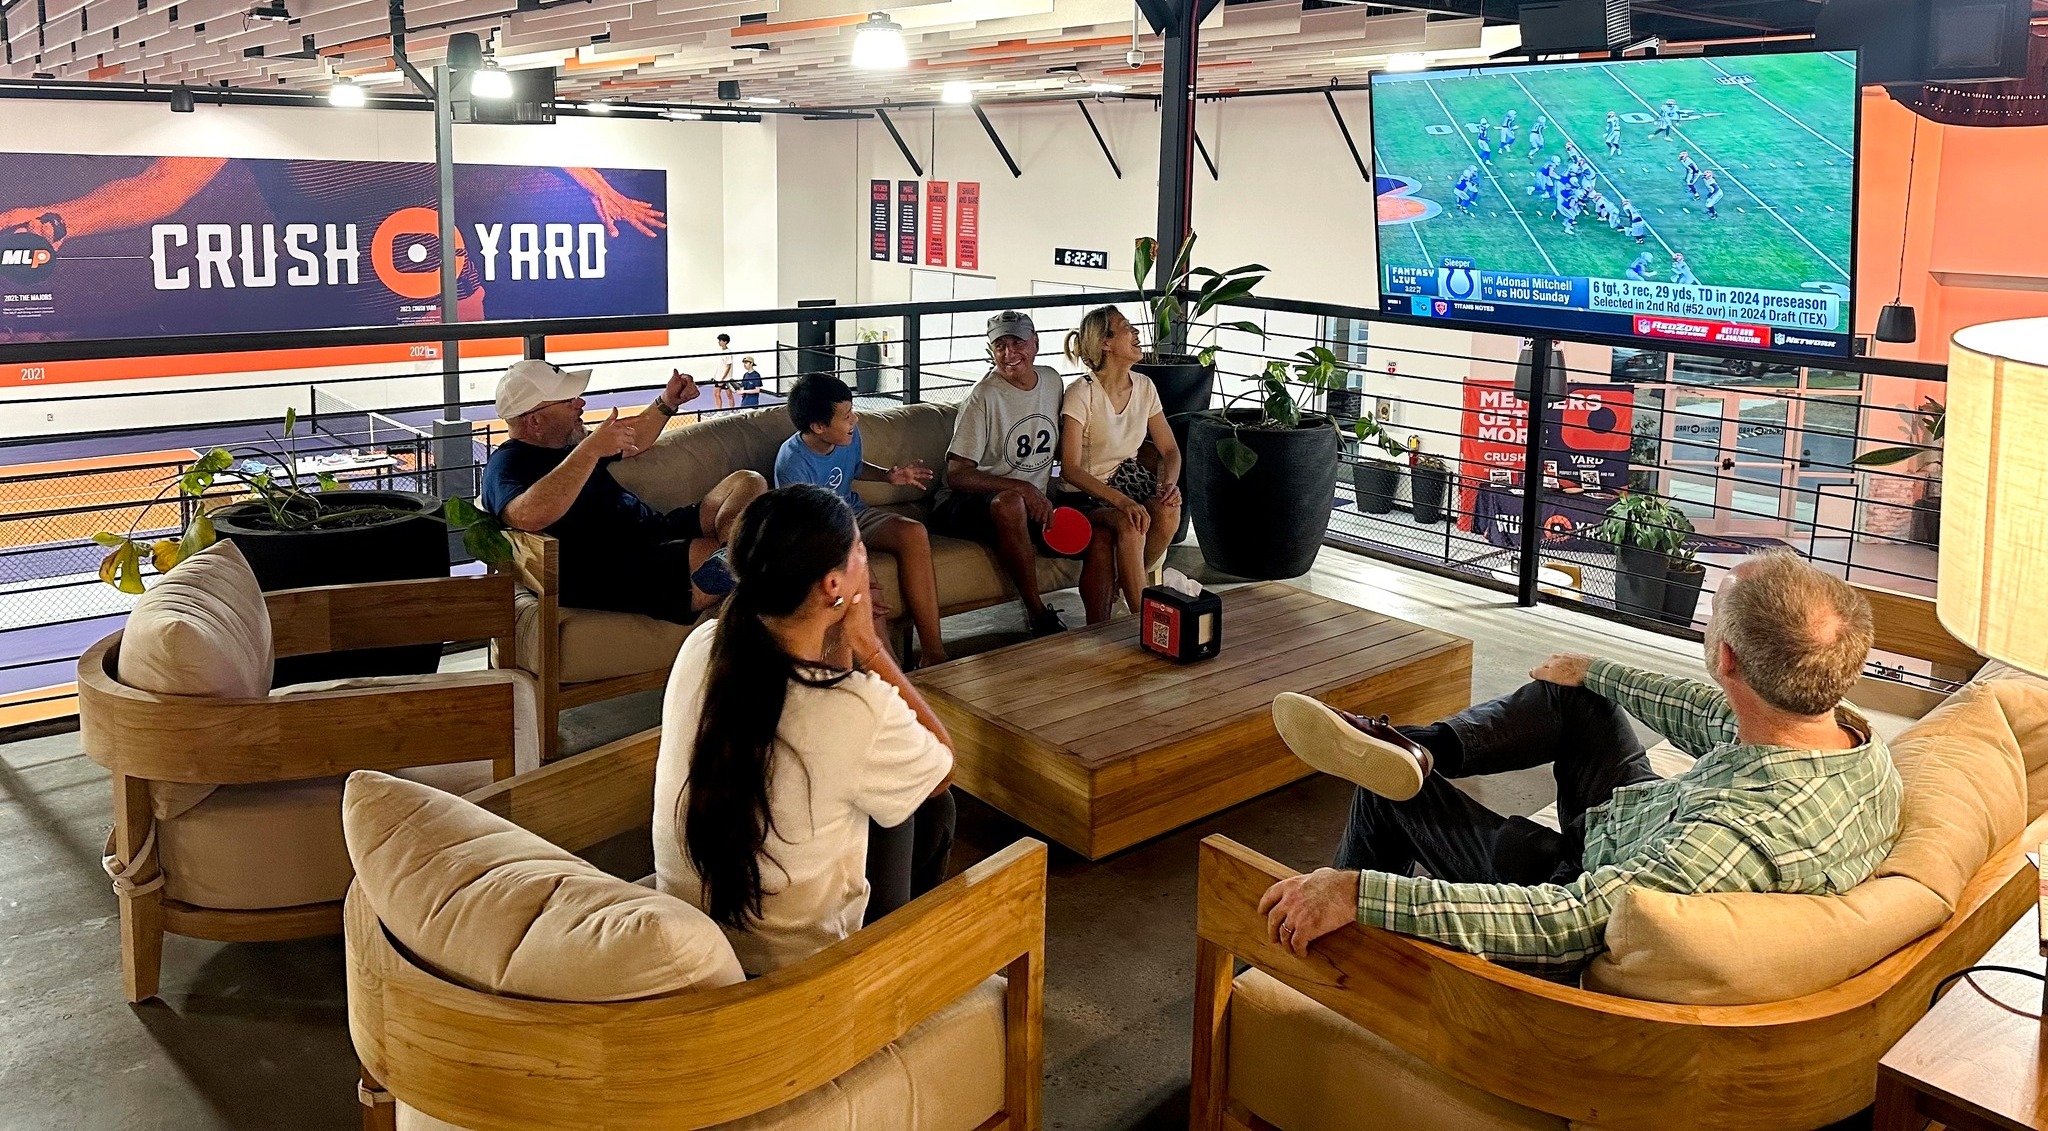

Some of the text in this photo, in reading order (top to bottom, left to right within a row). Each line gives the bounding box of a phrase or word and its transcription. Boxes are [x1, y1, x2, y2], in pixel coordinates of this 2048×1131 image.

[2, 250, 51, 268] MLP
[150, 223, 608, 290] CRUSH YARD
[1064, 250, 1103, 267] 6:22:24
[1444, 258, 1471, 268] Sleeper
[1392, 267, 1435, 278] FANTASY
[1392, 276, 1417, 285] LIVE
[1482, 276, 1494, 285] WR
[1496, 276, 1573, 291] Adonai Mitchell
[31, 293, 53, 301] MAJORS
[1484, 287, 1493, 295] 10
[1496, 288, 1570, 305] vs HOU Sunday
[1593, 281, 1827, 311] 6 tgt, 3 rec, 29 yds, TD in 2024 preseason
[1593, 296, 1827, 327] Selected in 2nd Rd (#52 ovr) in 2024 Draft (TEX)
[21, 367, 45, 381] 2021
[1480, 390, 1602, 411] MEERS
[1478, 409, 1529, 426] GET
[1478, 426, 1528, 444] MOR
[1484, 452, 1526, 462] CRUSH
[1570, 455, 1604, 465] YARD
